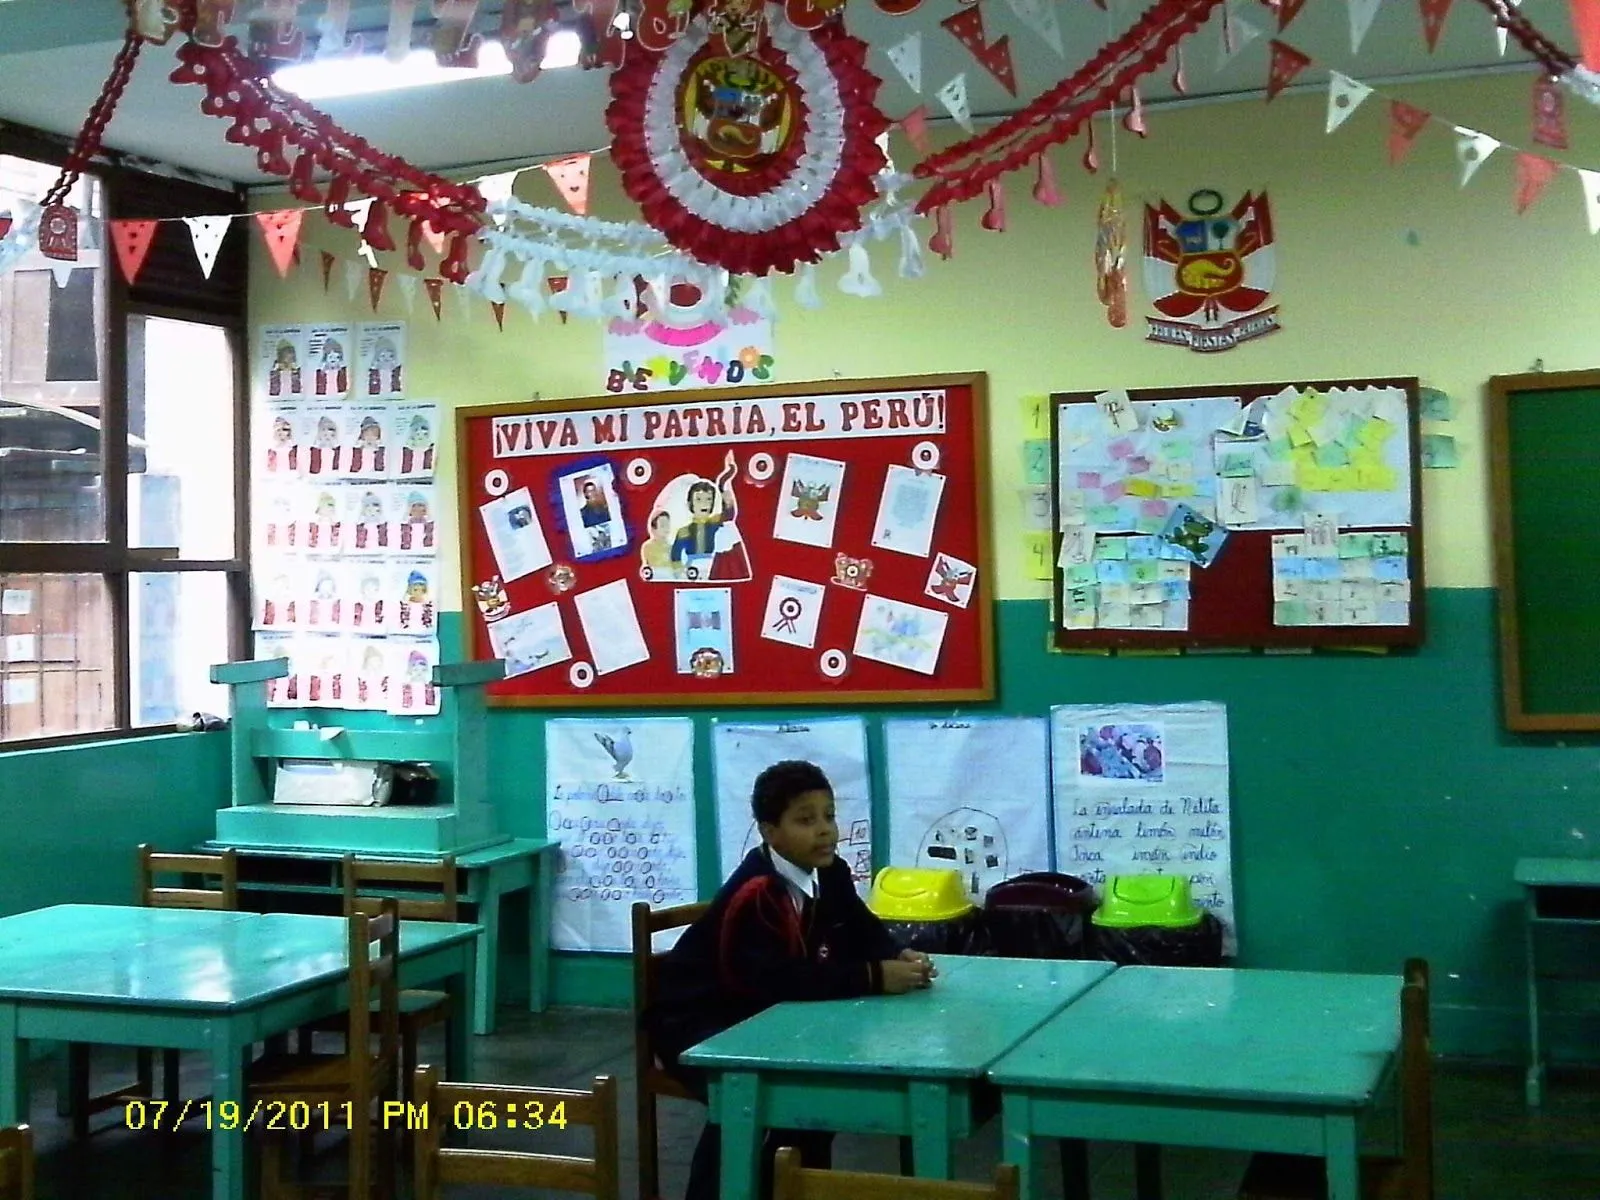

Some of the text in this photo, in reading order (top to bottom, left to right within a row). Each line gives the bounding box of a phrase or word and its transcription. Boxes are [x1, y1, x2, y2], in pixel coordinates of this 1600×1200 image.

[606, 346, 775, 393] BIEVENDOS
[782, 402, 826, 433] EL
[840, 393, 945, 432] PERÚ!
[1032, 542, 1045, 568] 4
